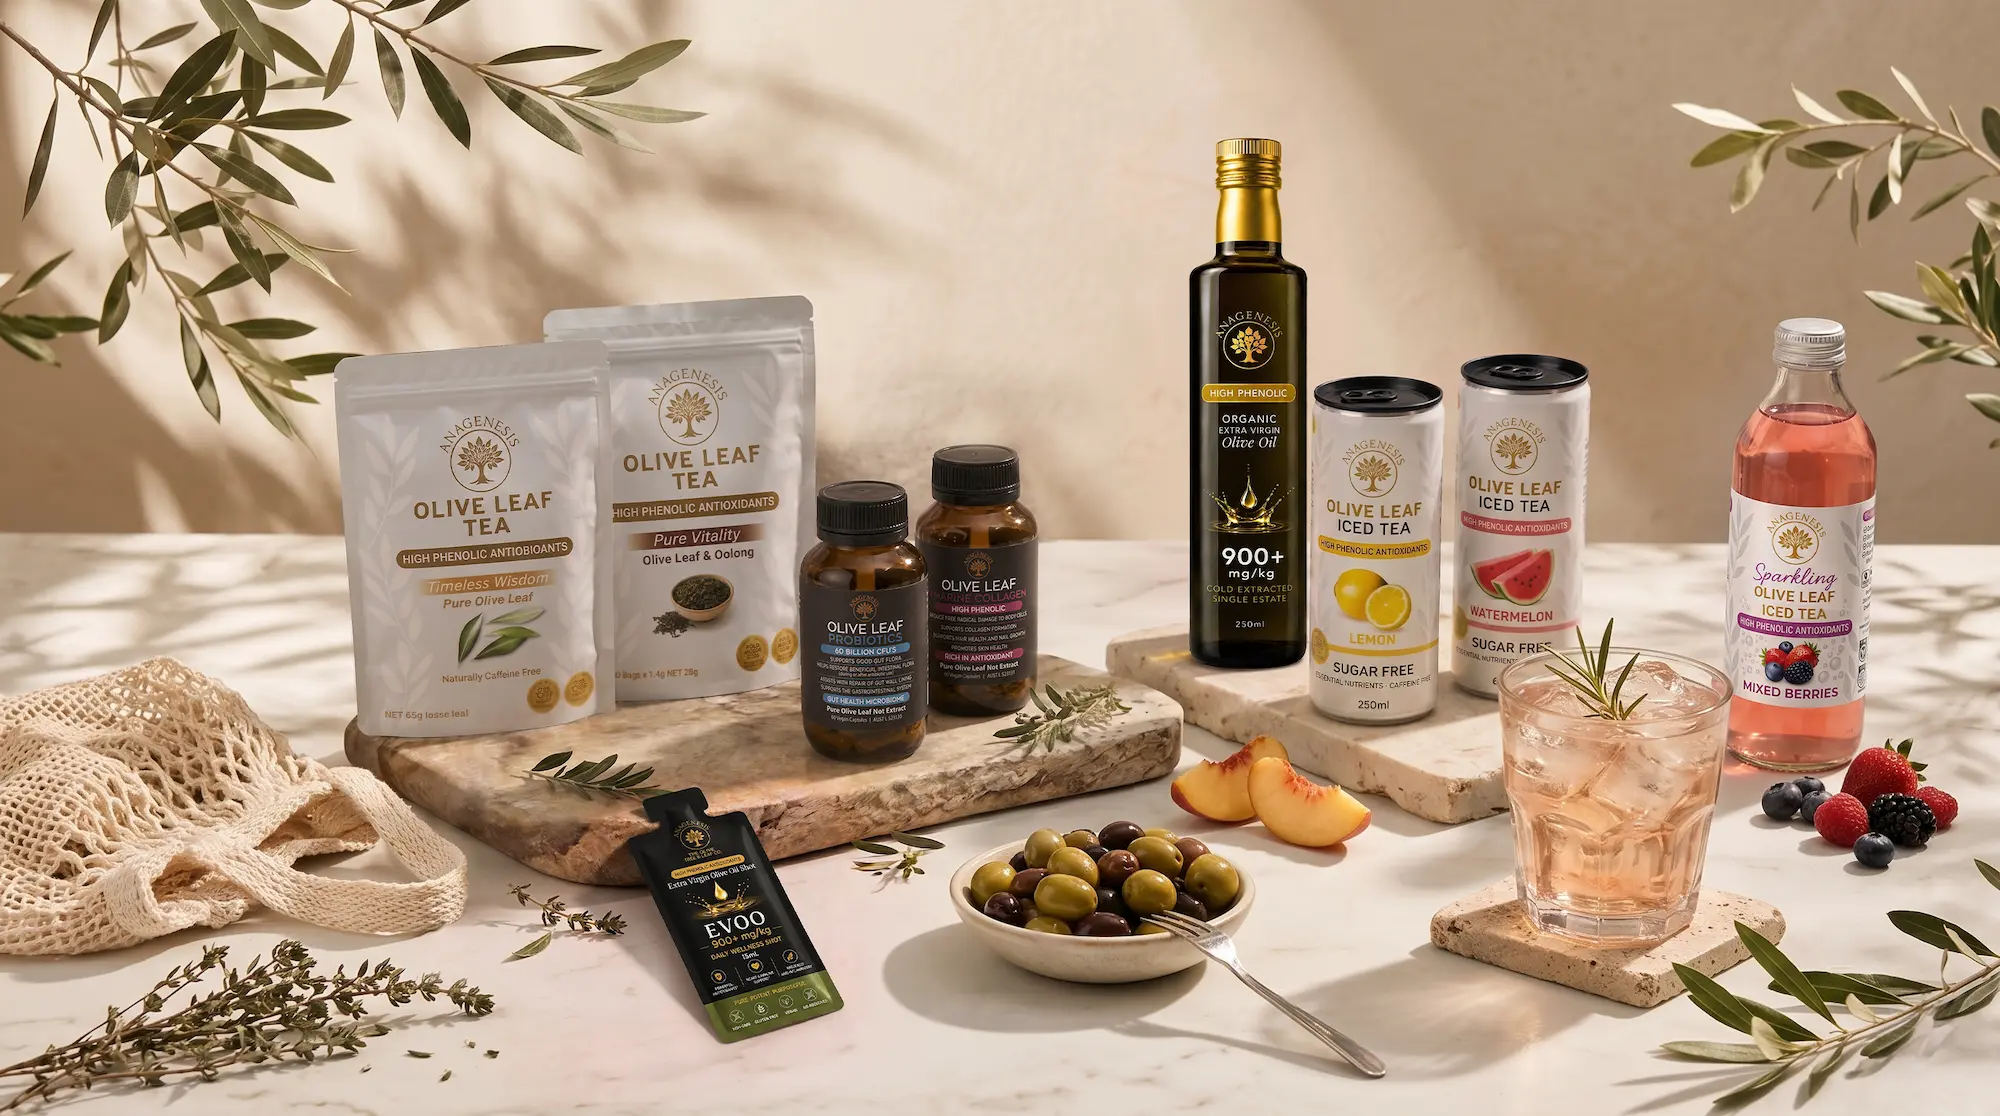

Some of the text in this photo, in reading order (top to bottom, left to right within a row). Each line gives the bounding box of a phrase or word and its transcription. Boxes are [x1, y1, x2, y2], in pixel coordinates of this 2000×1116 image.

[1215, 310, 1283, 339] ANAGENESIS
[647, 368, 729, 406] ANAGENESIS
[1209, 388, 1288, 398] HIGH PHENOLIC
[1221, 414, 1277, 424] ORGANIC
[439, 415, 520, 454] ANAGENESIS
[1218, 426, 1280, 434] EXTRA VIRGIN
[1483, 417, 1547, 445] ANAGENESIS
[1222, 436, 1277, 448] Olive Oil
[623, 444, 760, 473] OLIVE LEAF
[1341, 439, 1406, 466] ANAGENESIS
[672, 470, 719, 490] TEA
[1469, 475, 1562, 496] OLIVE LEAF
[413, 491, 553, 520] OLIVE LEAF
[613, 496, 775, 519] HIGH PHENOLIC ANTIOXIDANTS
[1326, 499, 1422, 519] OLIVE LEAF
[1479, 495, 1550, 513] ICED TEA
[463, 517, 511, 537] TEA
[1338, 519, 1411, 536] ICED TEA
[1463, 515, 1568, 532] HIGH PHENOLIC ANTIOXIDANTS
[1766, 511, 1827, 538] ANAGENESIS
[653, 529, 741, 547] Pure Vitality
[1221, 547, 1285, 566] 900+
[1320, 540, 1428, 556] HIGH PHENOLIC ANTIOXIDANTS
[402, 553, 430, 565] HIGH
[432, 549, 488, 563] PHENOLIC
[642, 548, 754, 566] Olive Leaf & Oolong
[427, 572, 549, 593] Timeless Wisdom
[1228, 567, 1275, 581] mg/kg
[1753, 562, 1838, 591] Sparkling
[941, 577, 1017, 593] OLIVE LEAF
[1206, 584, 1293, 593] COLD EXTRACTED
[443, 592, 534, 609] Pure Olive Leaf
[974, 588, 1027, 603] COLLAGEN
[1212, 594, 1287, 604] SINGLE ESTATE
[1754, 585, 1835, 603] OLIVE LEAF
[951, 604, 1006, 613] HIGH PHENOLIC
[1470, 604, 1553, 622] WATERMELON
[1762, 604, 1827, 620] ICED TEA
[827, 619, 904, 635] OLIVE LEAF
[1235, 620, 1265, 628] 250ml
[1740, 617, 1755, 628] HIGH
[1755, 620, 1794, 634] PHENOLIC
[1795, 623, 1850, 635] ANTIOXIDANTS
[828, 632, 903, 646] PROBIOTICS
[1349, 632, 1396, 645] LEMON
[1472, 637, 1515, 653] SUGAR
[834, 646, 897, 656] 60 BILLION CFU'S
[944, 652, 961, 661] RICH
[969, 650, 1014, 662] ANTIOXIDANT
[622, 670, 641, 681] Bags
[667, 668, 683, 677] NET
[683, 668, 699, 677] 28g
[939, 661, 954, 670] Pure
[954, 663, 971, 671] Olive
[971, 664, 986, 672] Leaf
[999, 660, 1019, 670] Extract
[1333, 661, 1414, 677] SUGAR FREE
[442, 668, 541, 684] Naturally Caffeine Free
[1315, 670, 1343, 686] ESSENTIAL
[1344, 679, 1383, 690] NUTRIENTS
[1389, 678, 1420, 689] CAFFEINE
[1743, 680, 1839, 699] MIXED BERRIES
[826, 694, 905, 705] GUT HEALTH MICROBIOME
[1358, 700, 1390, 710] 250ml
[384, 711, 404, 719] NET
[405, 711, 423, 721] 65g
[826, 705, 841, 714] Pure
[840, 707, 857, 715] Olive
[857, 708, 872, 716] Leaf
[885, 705, 907, 714] Extract
[667, 862, 757, 890] Extra Virgin Olive Oil Shot
[703, 910, 766, 939] EVOO
[711, 927, 772, 949] 900+ mg/kg
[710, 935, 782, 961] DAILY WELLNESS SHOT
[741, 950, 760, 960] 15mL
